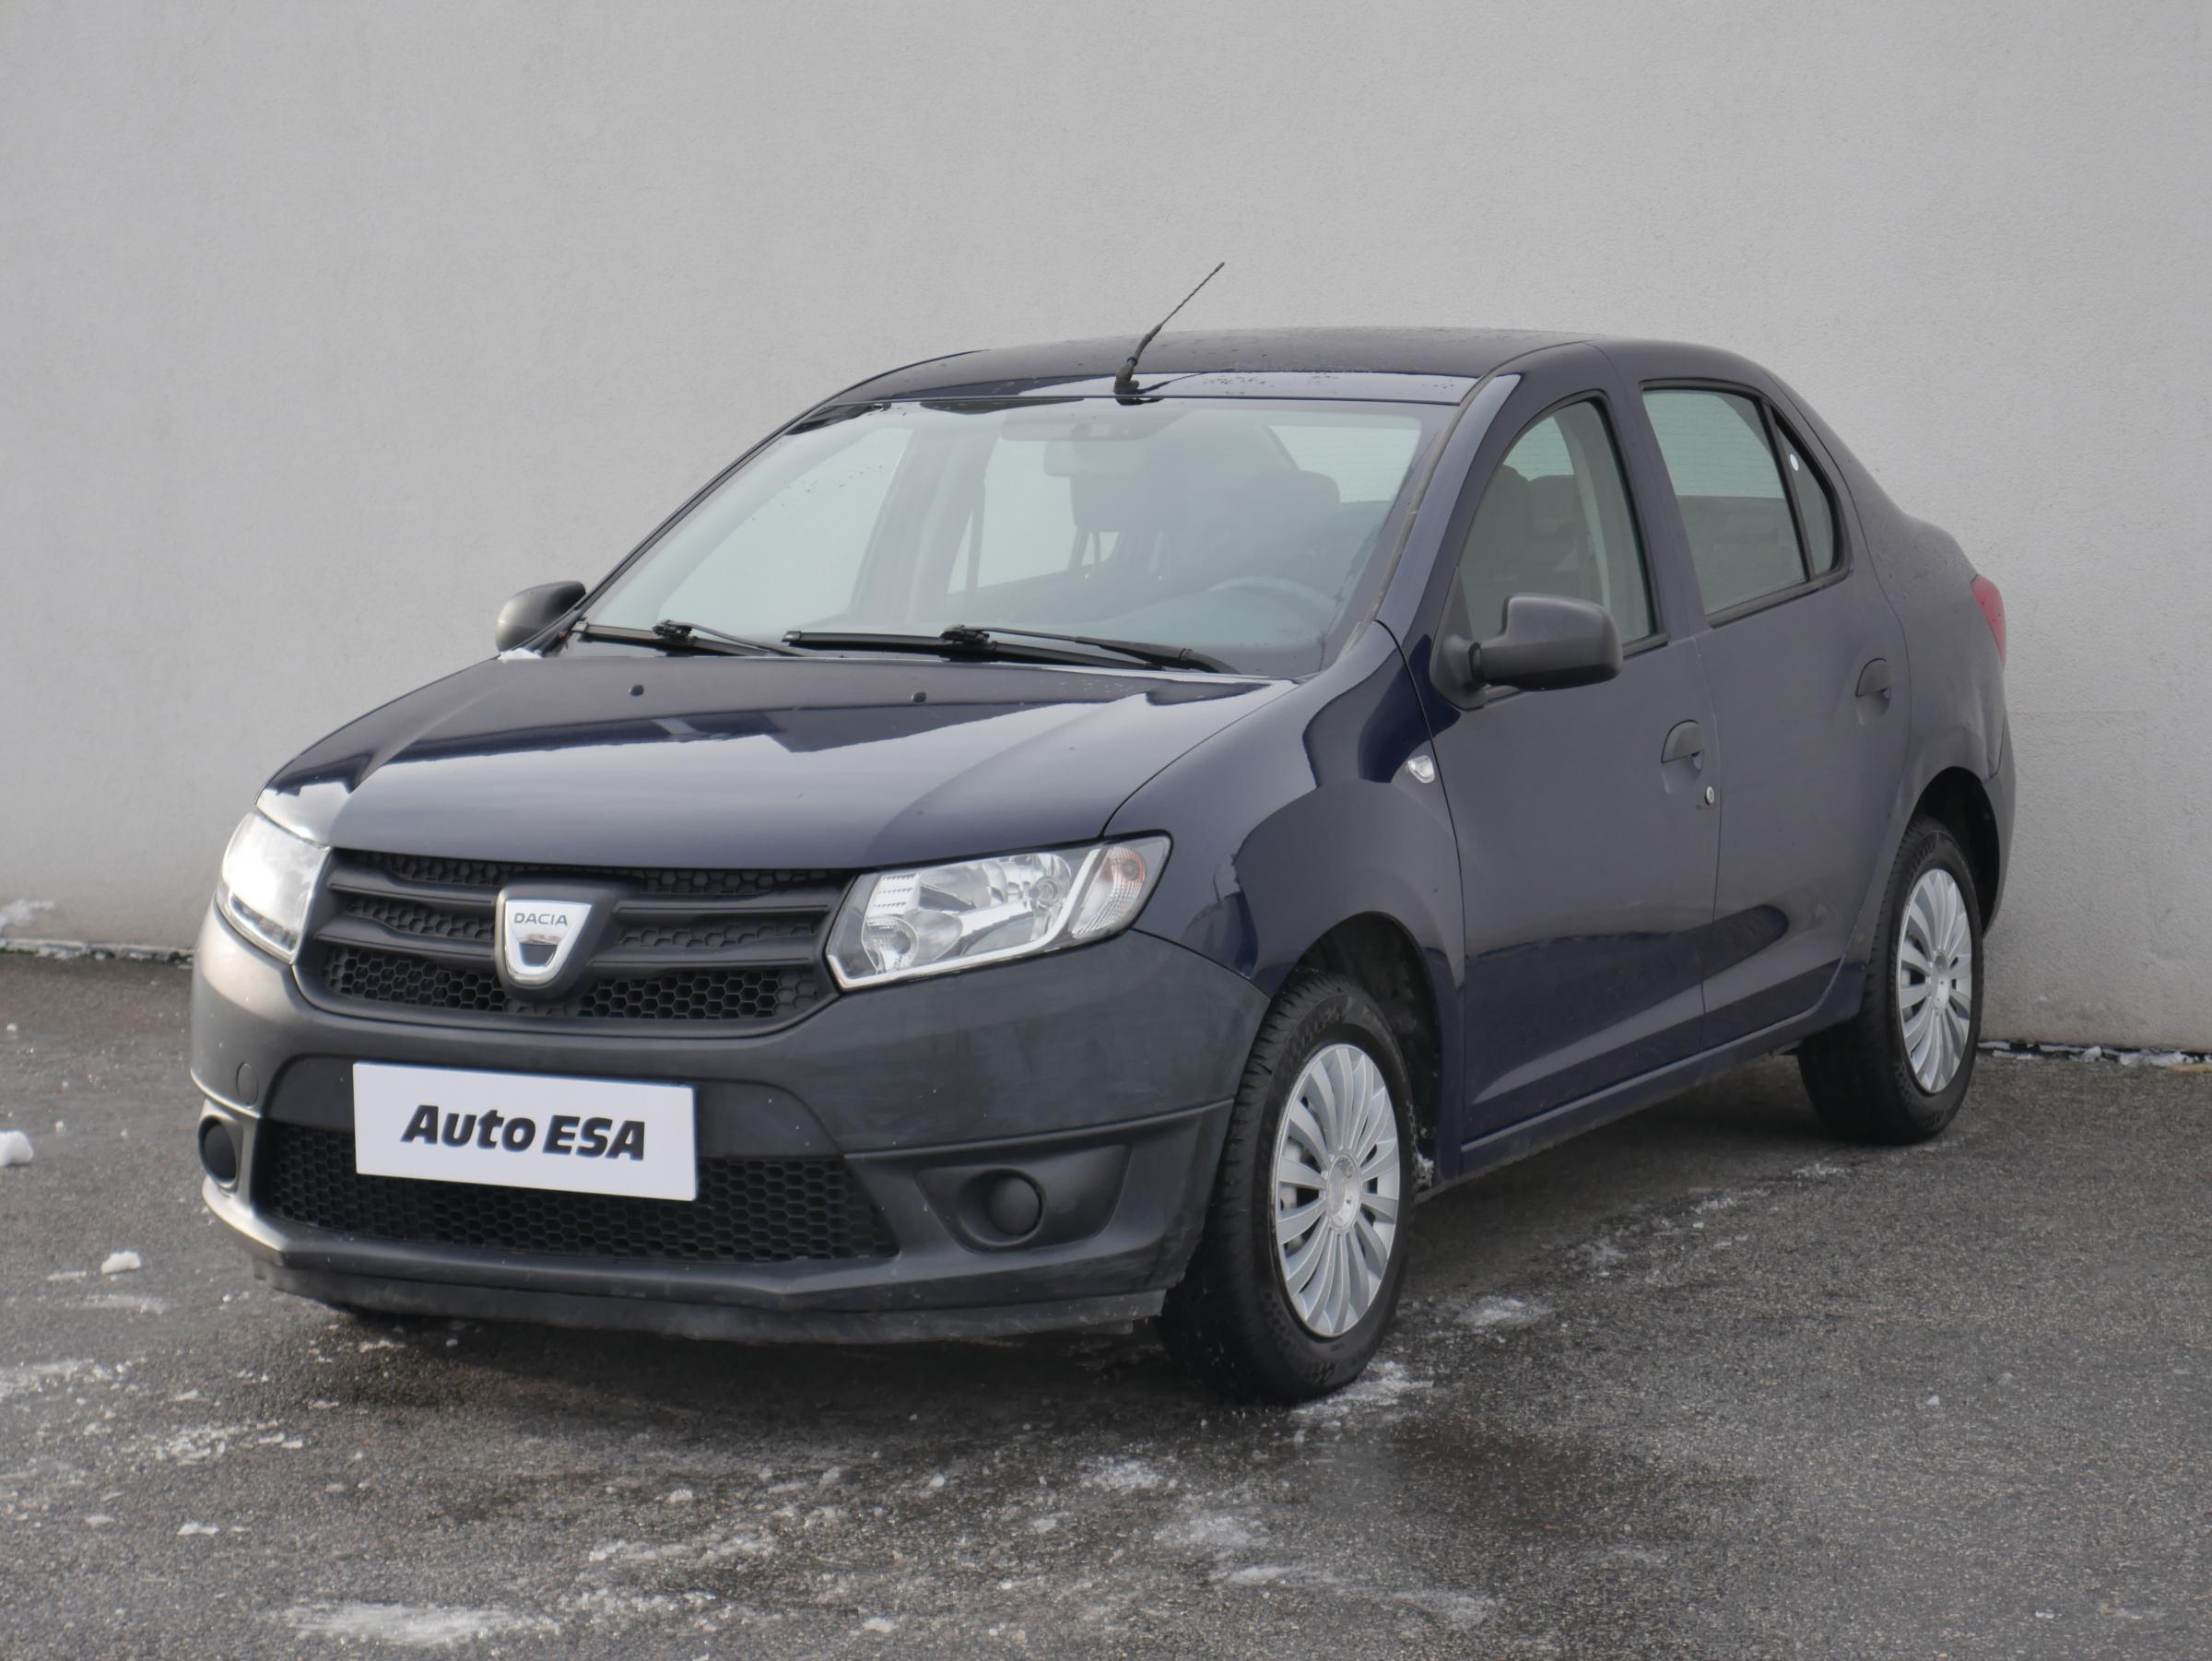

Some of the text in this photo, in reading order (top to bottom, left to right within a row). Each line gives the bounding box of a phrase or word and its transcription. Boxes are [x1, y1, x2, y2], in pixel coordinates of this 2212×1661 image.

[513, 913, 568, 926] DACIA
[400, 1104, 645, 1160] Auto ESA
